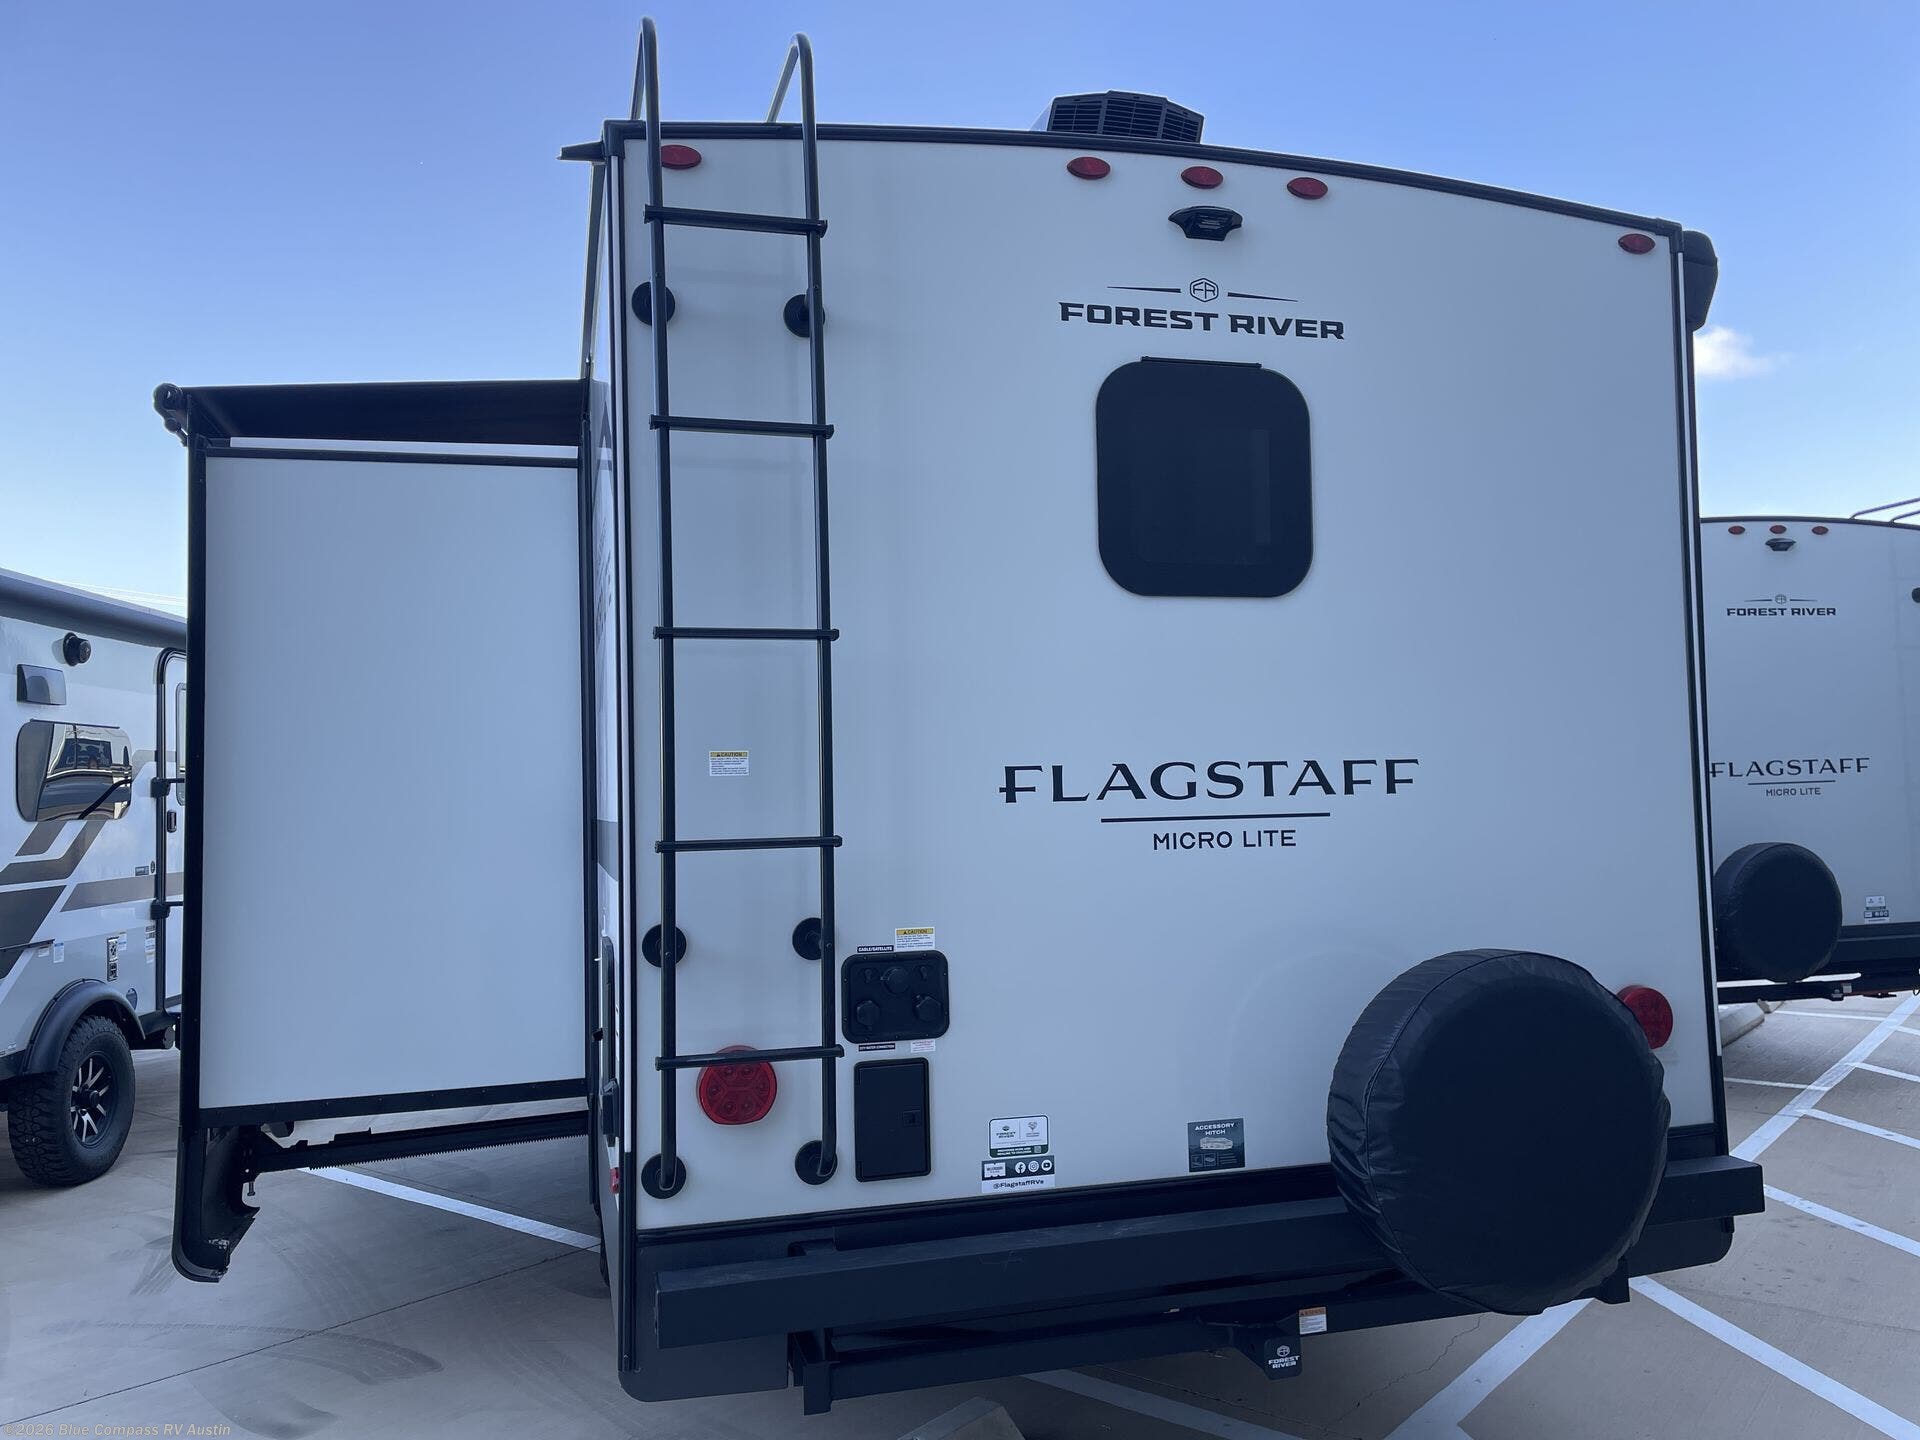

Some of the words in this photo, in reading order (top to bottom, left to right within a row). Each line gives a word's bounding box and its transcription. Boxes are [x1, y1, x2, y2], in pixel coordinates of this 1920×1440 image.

[1058, 301, 1219, 331] FOREST
[1227, 314, 1345, 340] RIVER
[1726, 607, 1787, 616] FOREST
[1791, 607, 1837, 616] RIVER
[1710, 757, 1871, 778] FLAGSTAFF
[999, 758, 1420, 804] FLAGSTAFF
[1765, 788, 1797, 797] MICRO
[1800, 787, 1822, 796] LITE
[1152, 831, 1233, 851] MICRO
[1242, 830, 1297, 848] LITE
[1195, 1122, 1235, 1131] ACCESSORY
[993, 1179, 1044, 1189] @FlagstaffRVs
[1268, 1355, 1300, 1365] FOREST
[1272, 1360, 1297, 1369] RIVER
